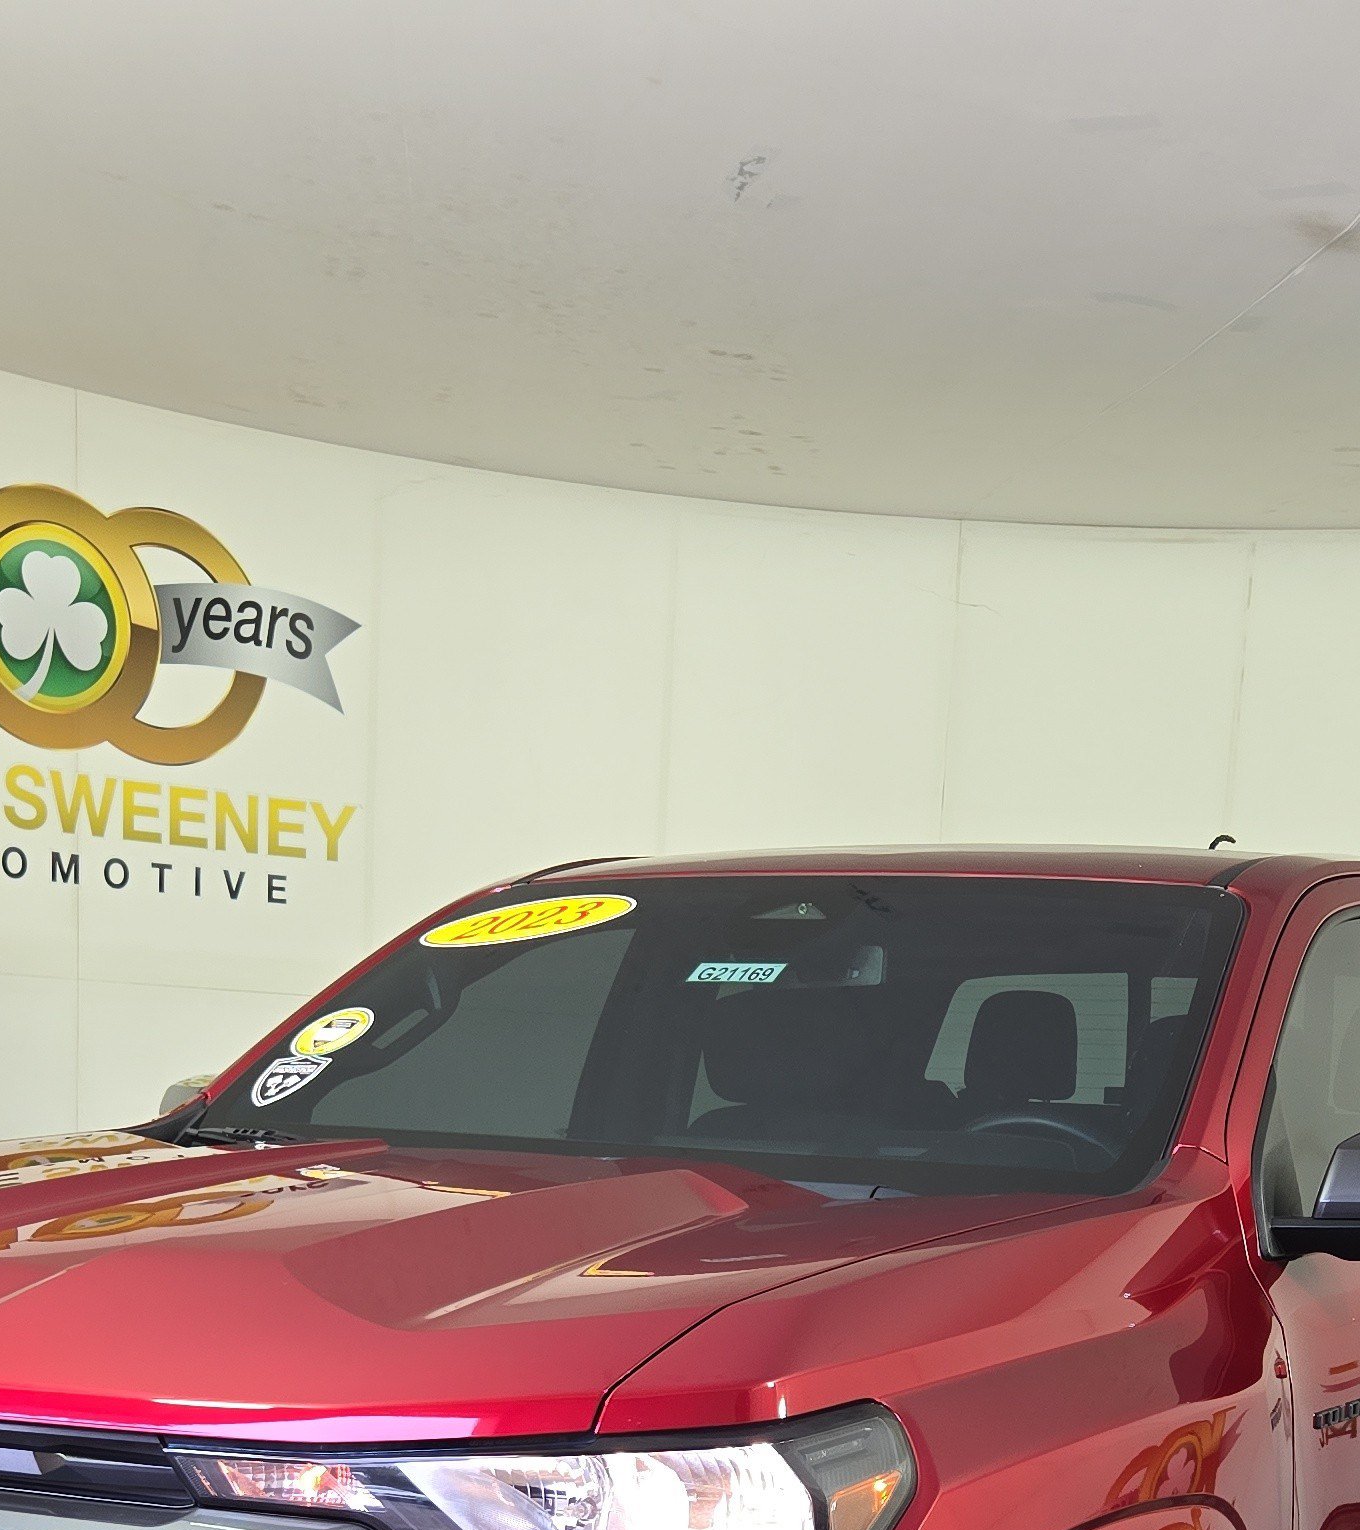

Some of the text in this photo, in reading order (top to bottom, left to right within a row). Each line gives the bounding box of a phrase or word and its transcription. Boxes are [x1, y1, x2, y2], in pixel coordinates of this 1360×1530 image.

[171, 595, 316, 660] years
[2, 764, 355, 862] SWEENEY
[449, 901, 605, 941] 2023
[697, 966, 775, 982] G21169
